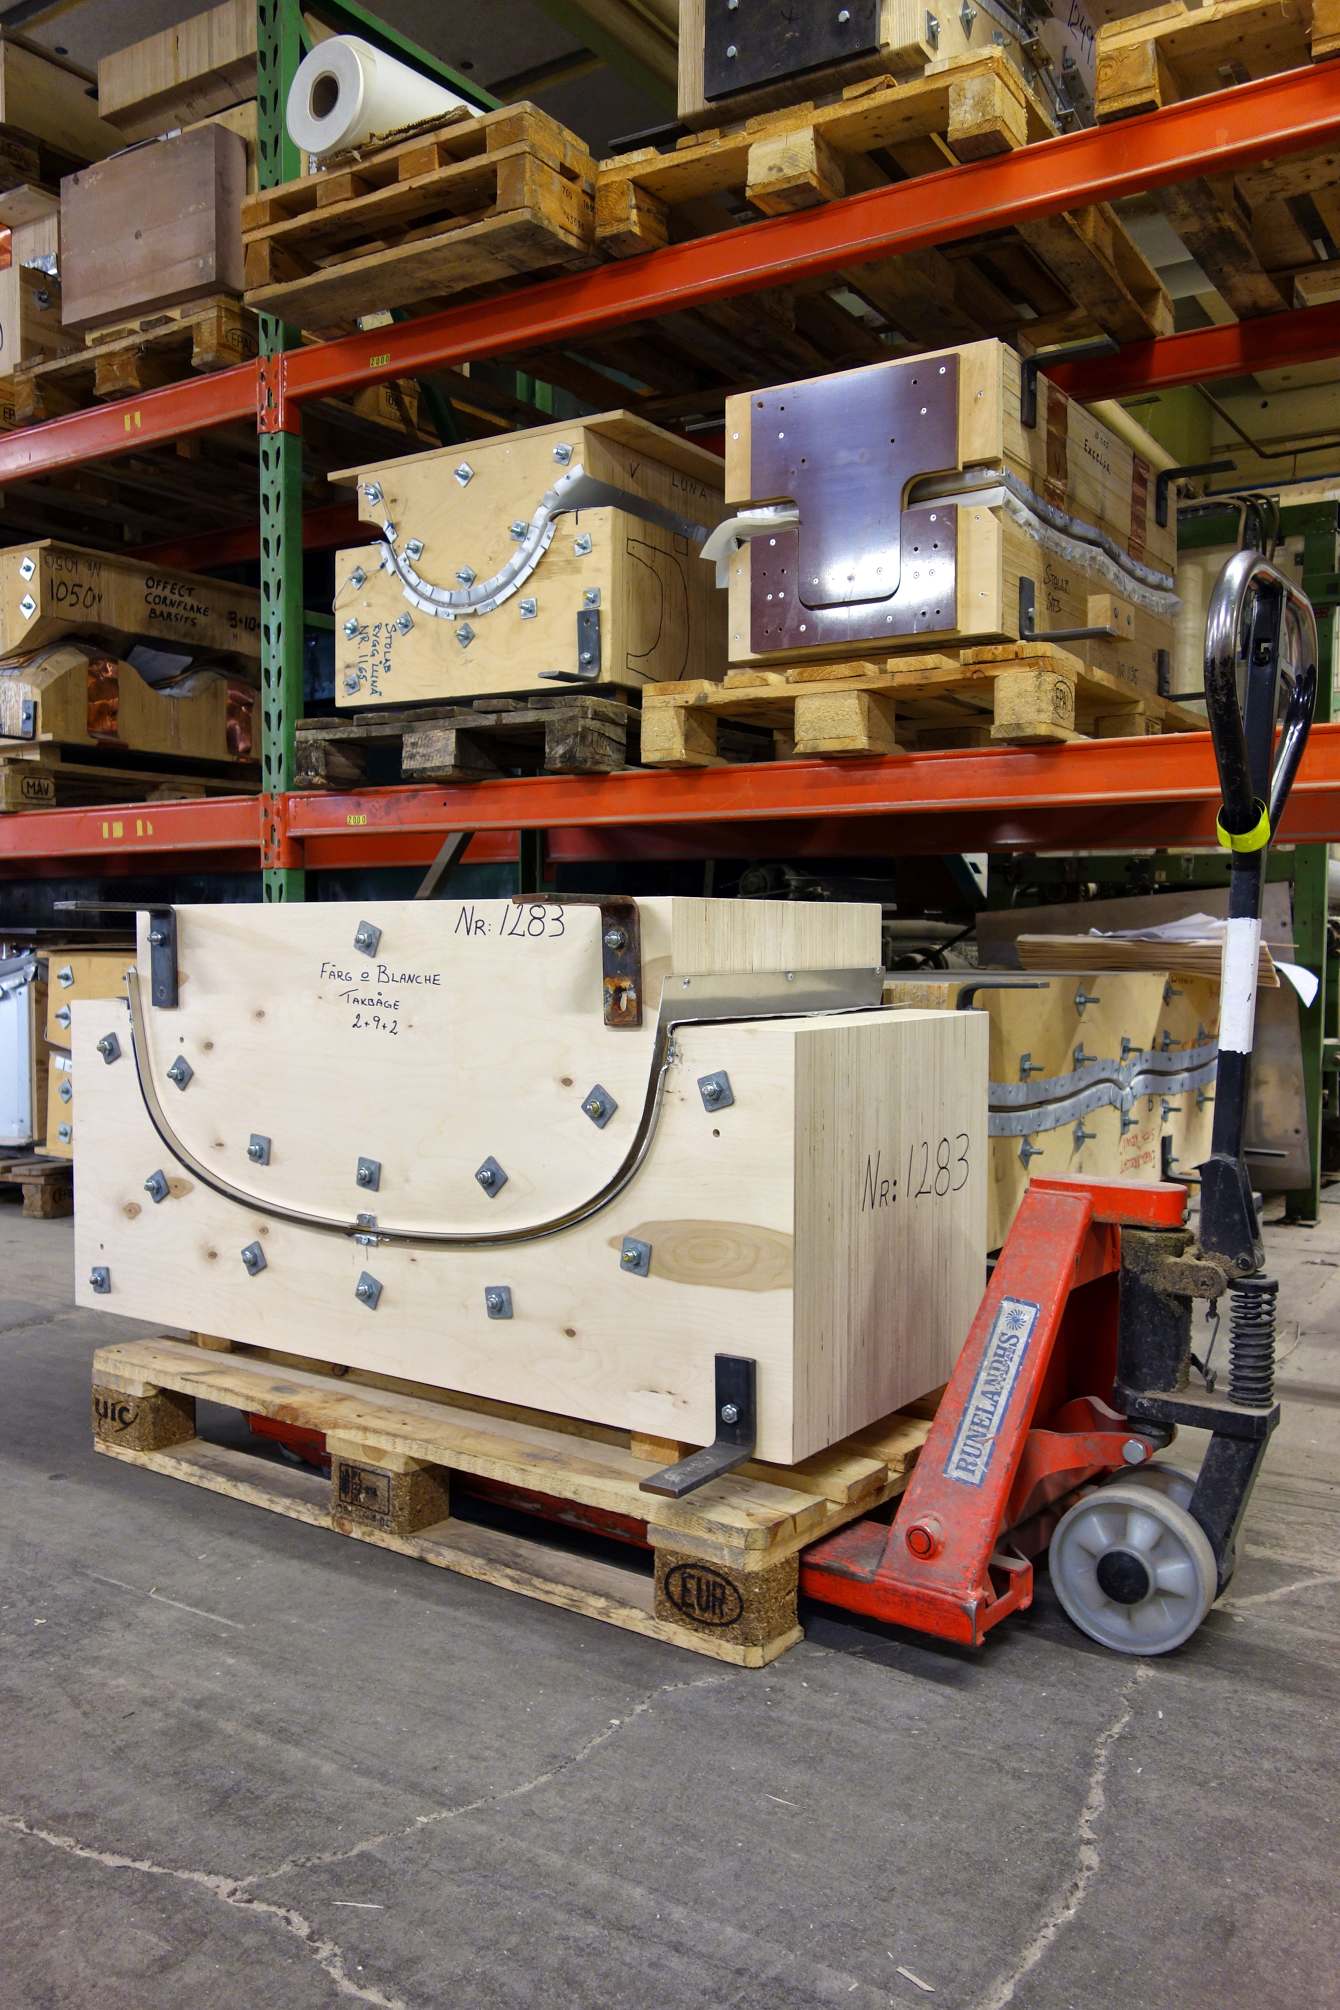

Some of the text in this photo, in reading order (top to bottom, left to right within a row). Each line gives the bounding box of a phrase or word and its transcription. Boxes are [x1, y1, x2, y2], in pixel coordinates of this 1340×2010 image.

[144, 592, 210, 617] CORNFLAKE
[369, 622, 383, 658] RYGG
[382, 622, 397, 673] STOLAB
[499, 903, 566, 938] 1283
[376, 963, 442, 987] BLANCHE
[906, 1132, 970, 1199] 1283
[954, 1331, 1021, 1477] RUNELANDHS
[681, 1570, 727, 1617] EUR
